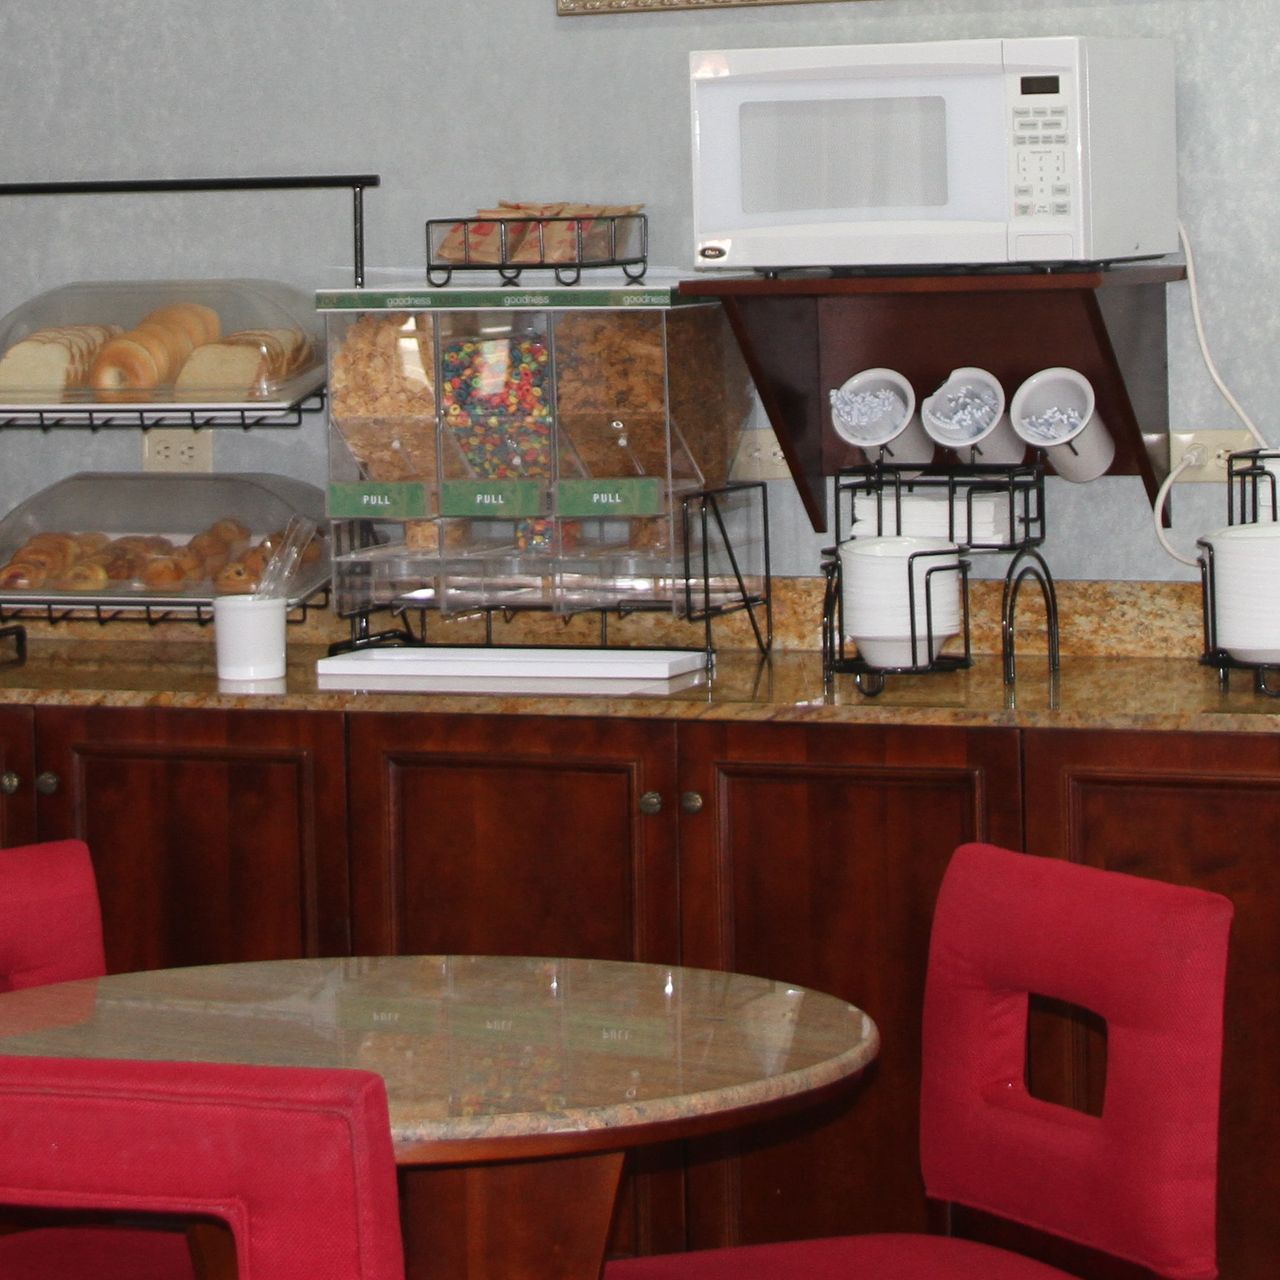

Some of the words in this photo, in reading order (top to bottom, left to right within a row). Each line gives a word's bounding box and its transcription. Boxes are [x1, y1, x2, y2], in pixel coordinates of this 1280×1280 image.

[386, 296, 431, 308] goodness
[504, 294, 549, 306] goodness
[623, 293, 669, 305] goodness
[363, 495, 391, 505] PULL
[476, 494, 504, 504] PULL
[593, 493, 622, 503] PULL
